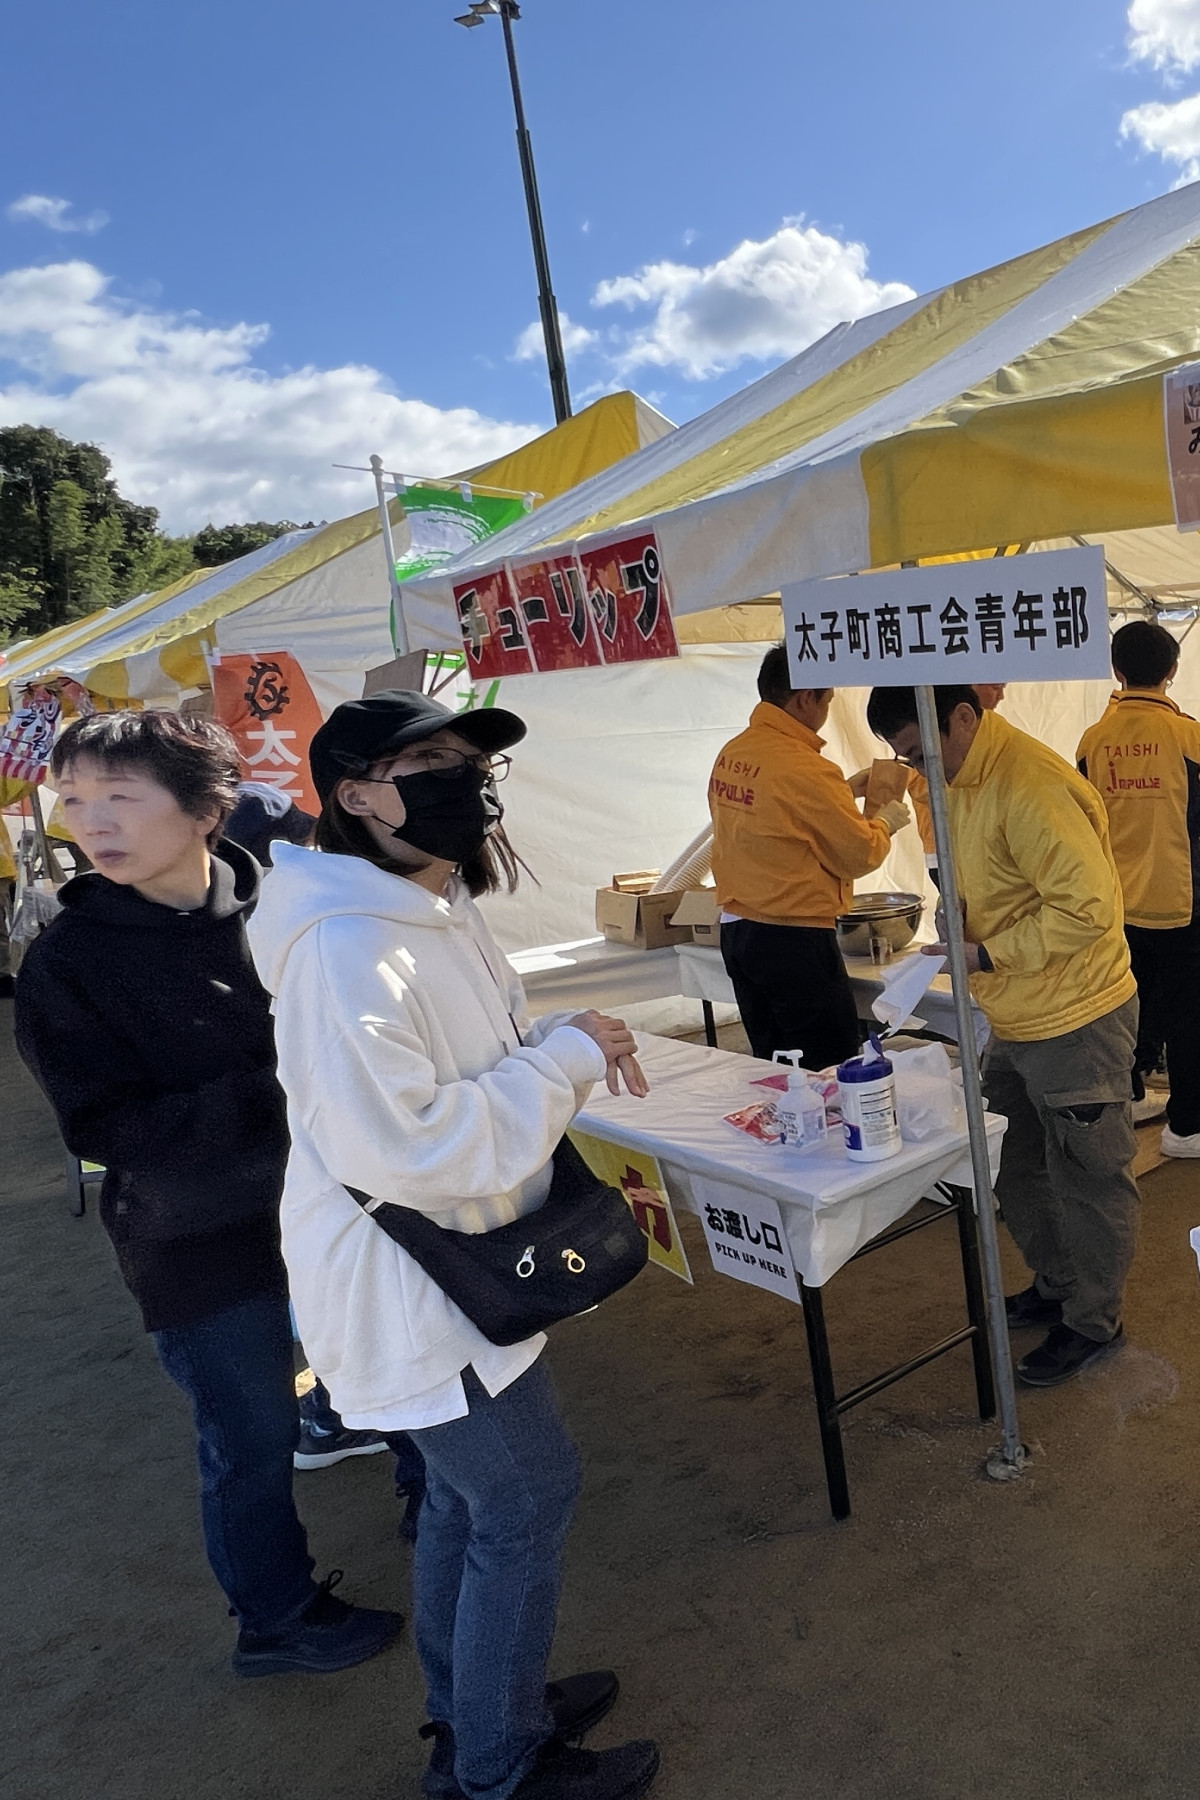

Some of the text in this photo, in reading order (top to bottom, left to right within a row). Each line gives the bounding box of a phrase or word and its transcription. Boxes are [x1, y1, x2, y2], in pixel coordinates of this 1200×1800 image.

[457, 545, 661, 664] チューリップ
[794, 586, 1089, 663] 太子町商工会青年部
[717, 755, 761, 778] AISHI
[1104, 743, 1159, 758] TAISHI
[704, 1202, 784, 1255] お渡し口
[715, 1241, 787, 1279] PICK UP HERE
